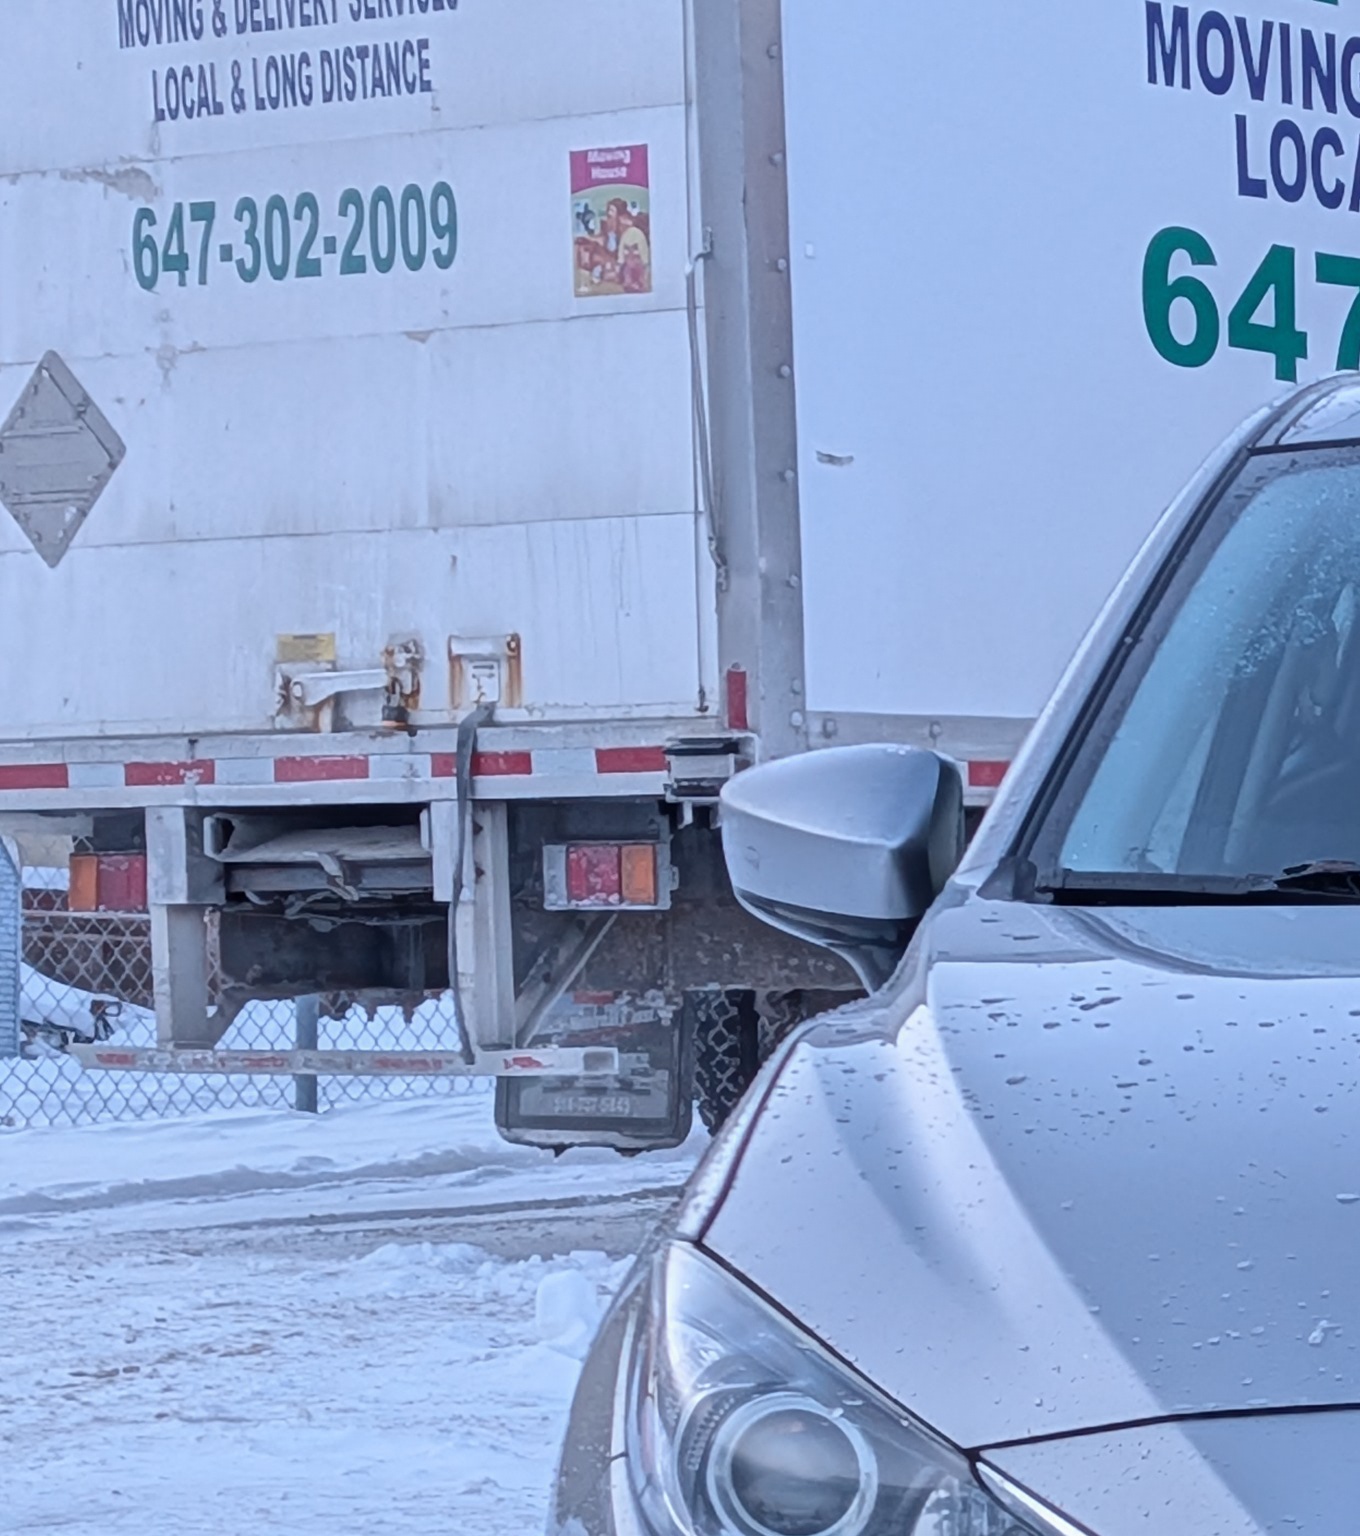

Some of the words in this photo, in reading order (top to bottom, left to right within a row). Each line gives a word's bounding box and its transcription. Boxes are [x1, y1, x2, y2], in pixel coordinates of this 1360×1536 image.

[119, 0, 203, 48] MOVING
[152, 62, 224, 122] LOCAL
[231, 60, 246, 114] &
[252, 51, 313, 111] LONG
[320, 38, 432, 104] DISTANCE
[132, 181, 459, 292] 647-302-2009
